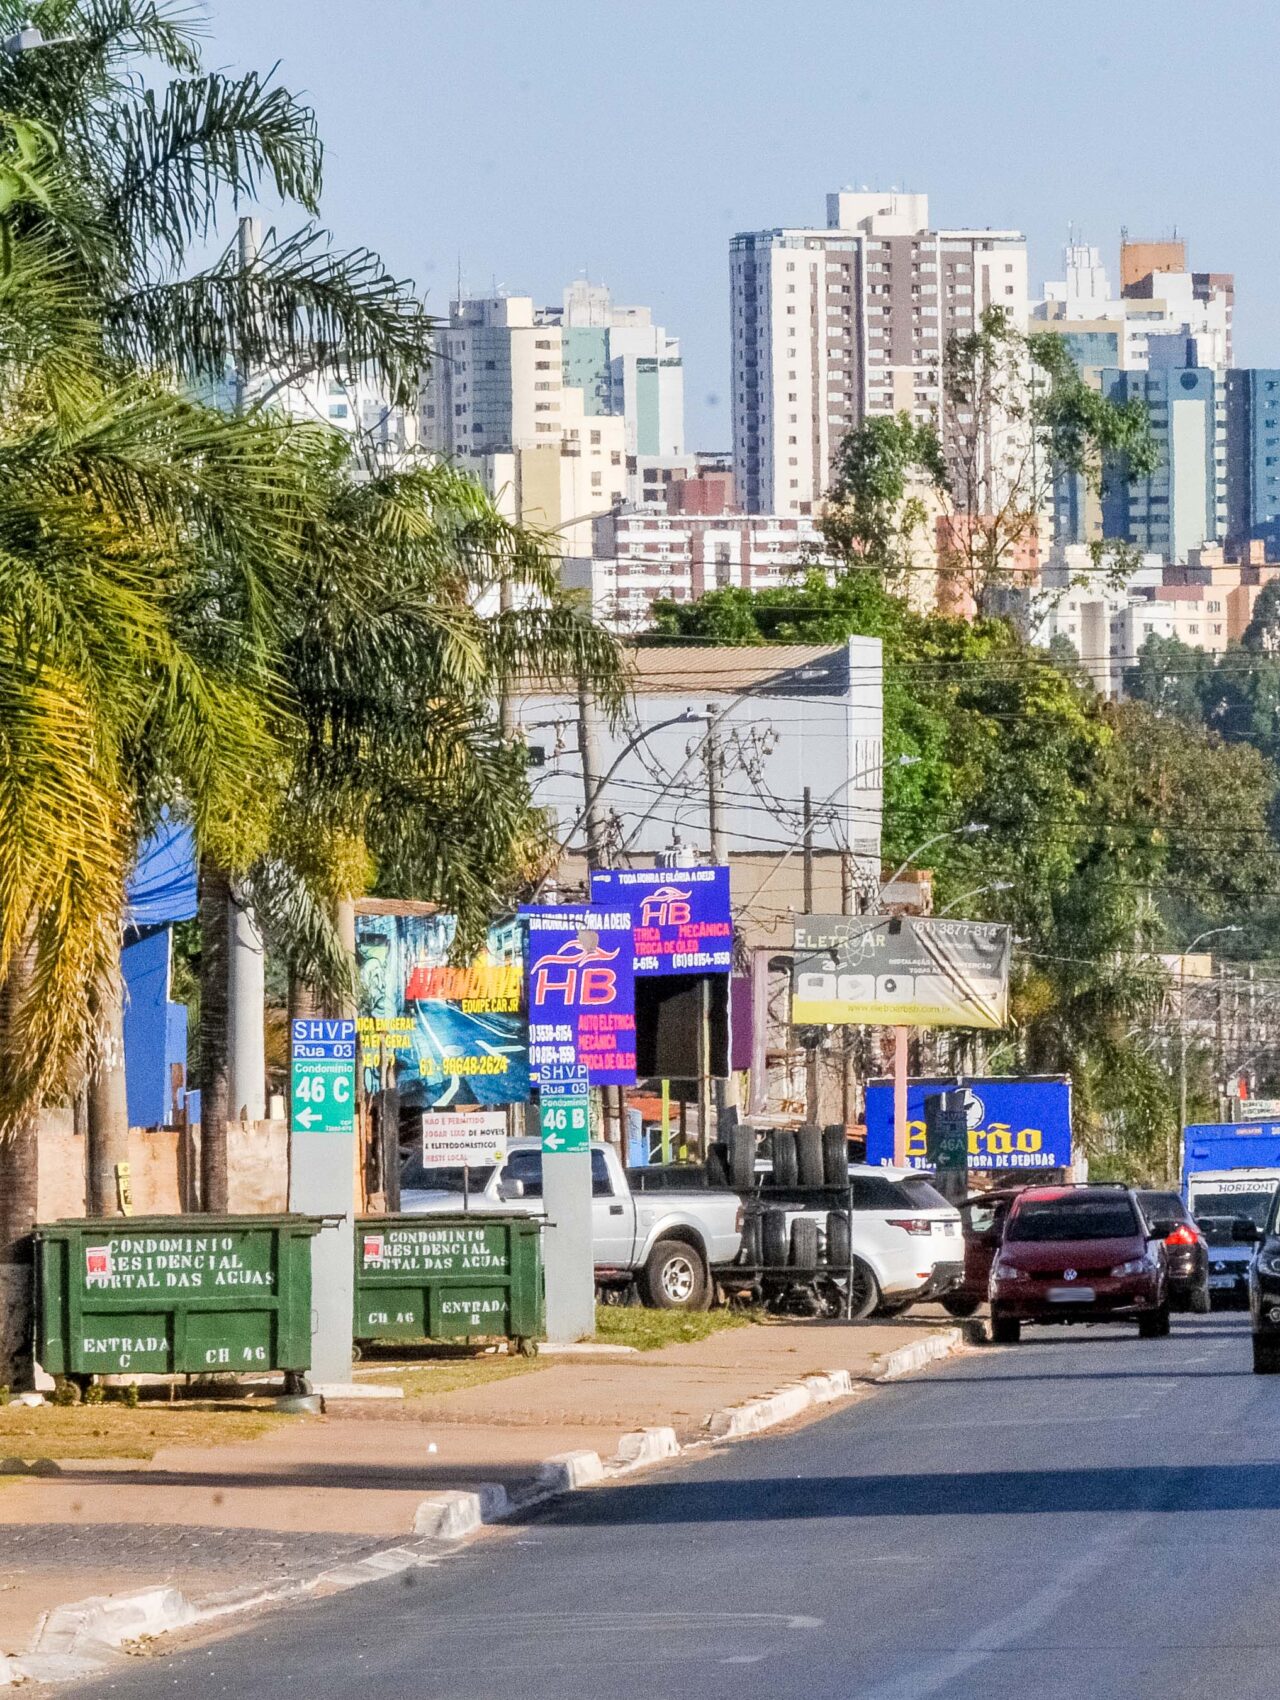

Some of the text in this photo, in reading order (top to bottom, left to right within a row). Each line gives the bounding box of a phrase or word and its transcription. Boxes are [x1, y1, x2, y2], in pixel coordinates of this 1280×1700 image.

[618, 874, 636, 884] TODA
[697, 870, 715, 881] DEUS
[542, 913, 568, 930] HONRA
[610, 912, 631, 930] DEUS
[642, 902, 691, 926] HB
[678, 921, 730, 937] MECÂNICA
[912, 921, 1000, 937] (61) 3877-814
[635, 941, 663, 955] TROCA
[664, 941, 675, 954] DE
[535, 968, 617, 1005] HB
[462, 999, 519, 1013] EQUIPE CAR JR
[390, 1017, 416, 1030] GERAL
[578, 1014, 599, 1031] AUTO
[295, 1021, 354, 1040] SHVP
[385, 1034, 411, 1047] GERAL
[578, 1031, 617, 1050] MECÂNICA
[294, 1045, 352, 1057] Rua 03
[419, 1058, 433, 1076] 61
[541, 1065, 587, 1080] SHVP
[295, 1076, 350, 1103] 46 C
[540, 1083, 586, 1094] Rua 03
[543, 1108, 586, 1130] 46 B
[424, 1129, 448, 1138] JOGAR
[905, 1121, 1043, 1157] Brão
[996, 1155, 1009, 1167] DE
[1011, 1153, 1056, 1167] BEBIDAS
[389, 1230, 486, 1243] CONDOMINIO
[108, 1238, 233, 1254] CONDOMINIO
[384, 1243, 490, 1257] RESIDENCIAL
[109, 1254, 243, 1272] RESIDENCIAL
[424, 1258, 453, 1269] DAS
[462, 1255, 510, 1267] AGUAS
[86, 1271, 275, 1289] PORTAL DAS AGUAS
[442, 1300, 509, 1314] ENTRADA
[368, 1312, 415, 1324] CH 46
[471, 1314, 481, 1325] B
[83, 1338, 170, 1352] ENTRADA
[119, 1354, 131, 1368] C
[205, 1346, 266, 1363] CH 46
